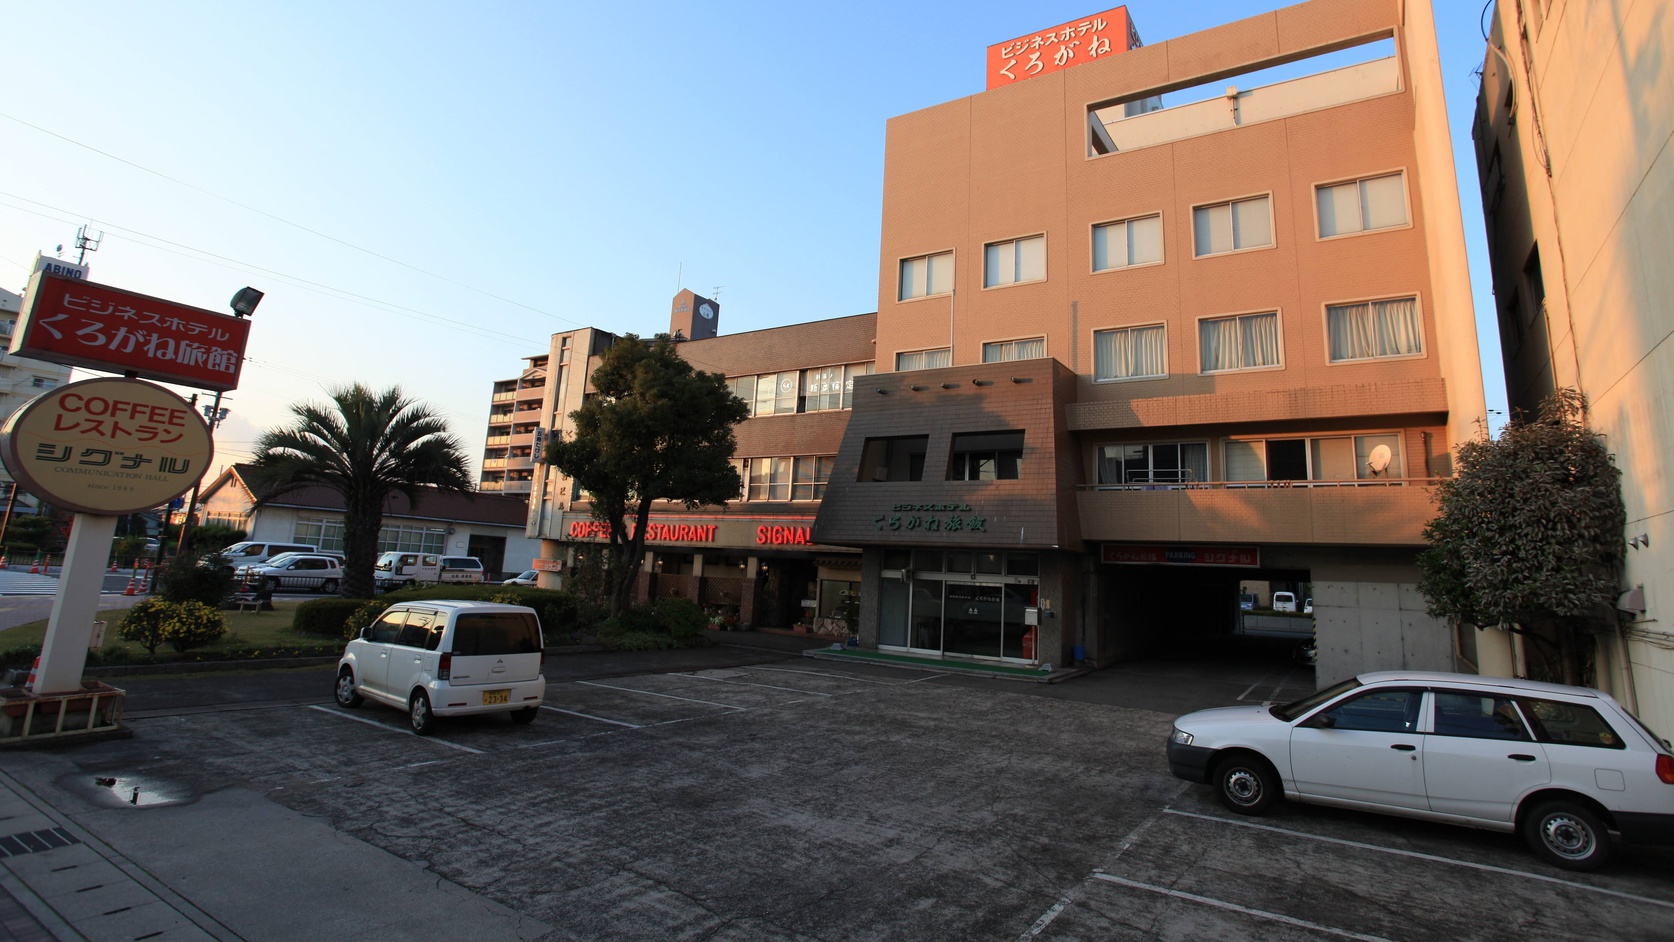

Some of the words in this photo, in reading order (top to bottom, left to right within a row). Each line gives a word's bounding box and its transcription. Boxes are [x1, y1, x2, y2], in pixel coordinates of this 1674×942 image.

[1001, 17, 1107, 59] ビジネスホテル
[1000, 35, 1111, 80] くろがね
[45, 262, 82, 279] ABINO
[63, 293, 230, 342] ビジネスホテル
[39, 313, 238, 374] くろがね旅館
[58, 393, 187, 427] COFFEE
[54, 413, 184, 443] レストラン
[35, 442, 190, 474] シグナル
[54, 466, 142, 480] COMMUNICATION
[145, 474, 169, 482] HALL
[112, 484, 135, 492] 1969
[892, 503, 971, 512] ビジネスホテル
[756, 525, 814, 546] SIGNAL
[1164, 551, 1196, 560] PARKING
